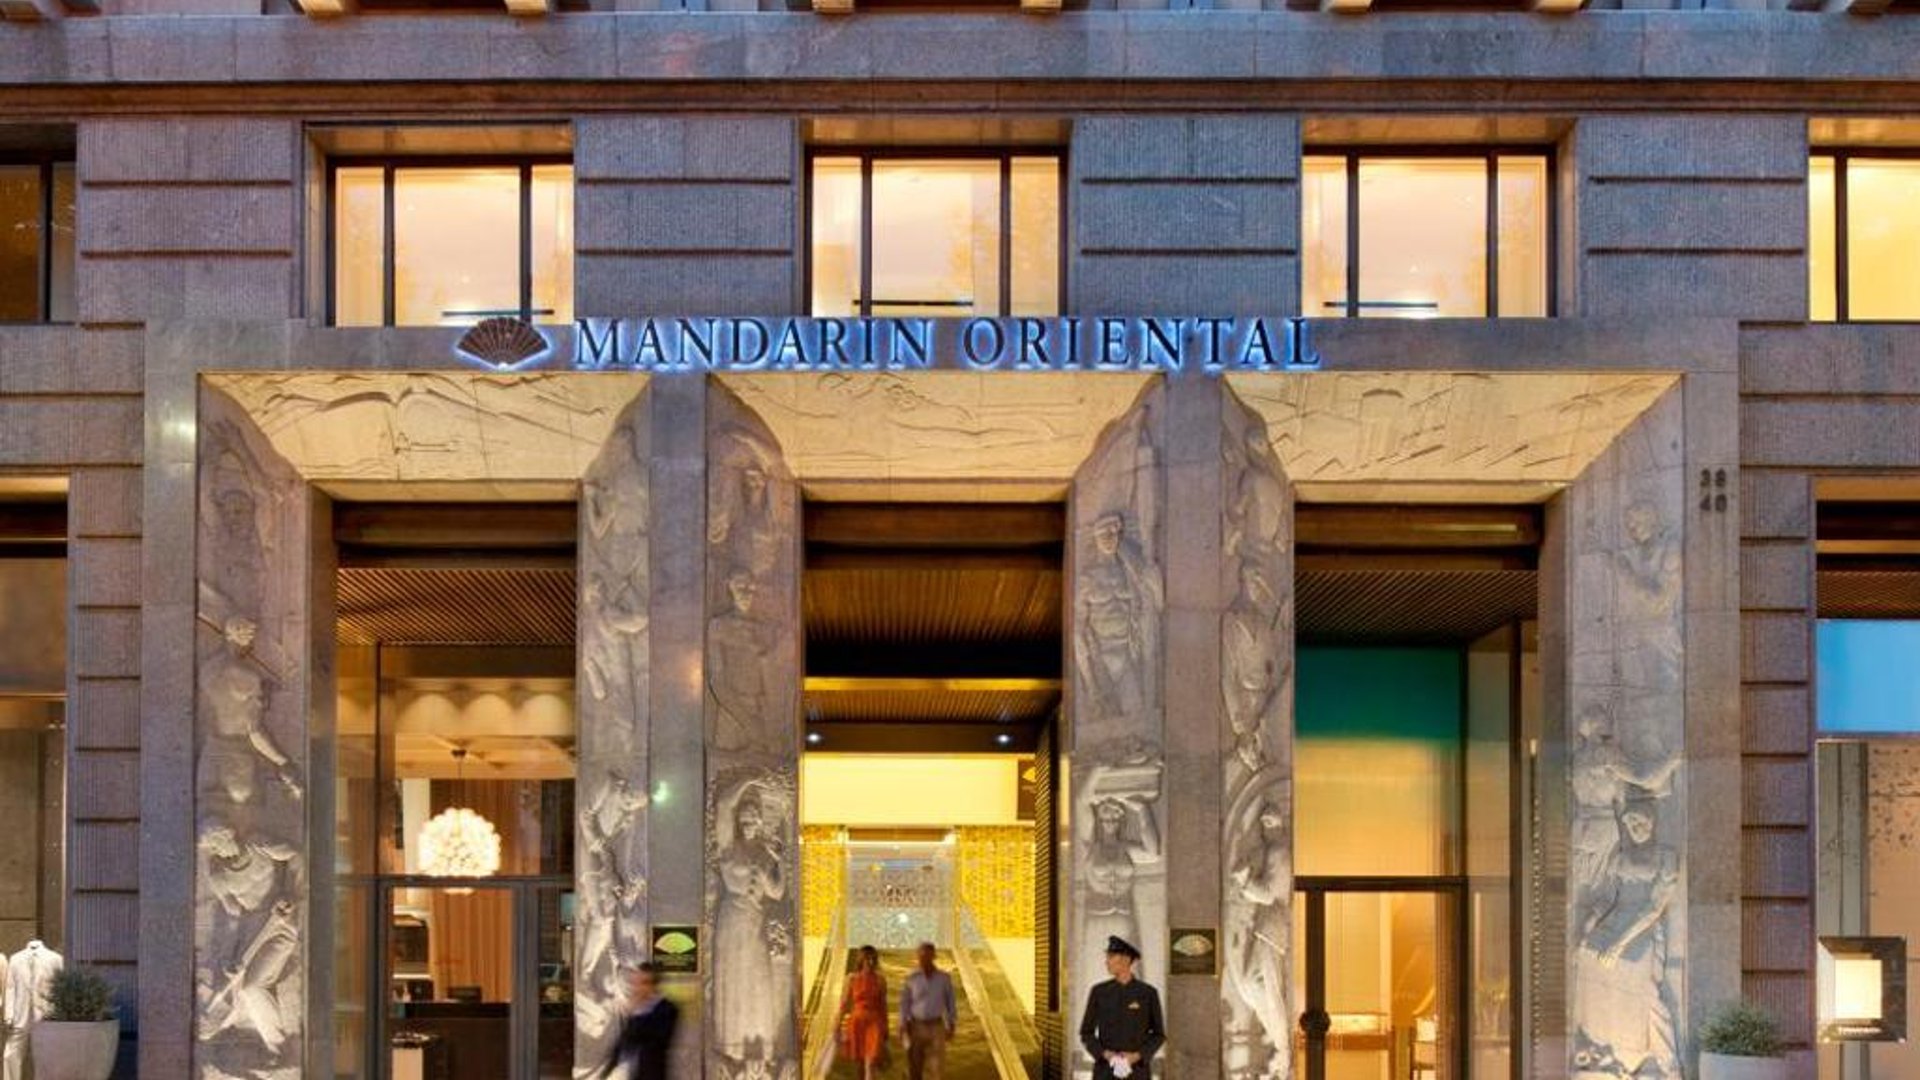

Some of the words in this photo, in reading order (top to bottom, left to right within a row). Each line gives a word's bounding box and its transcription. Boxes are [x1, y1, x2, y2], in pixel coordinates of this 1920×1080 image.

[577, 318, 930, 366] MANDARIN
[963, 317, 1320, 366] ORIENTAL
[1699, 493, 1727, 513] 40
